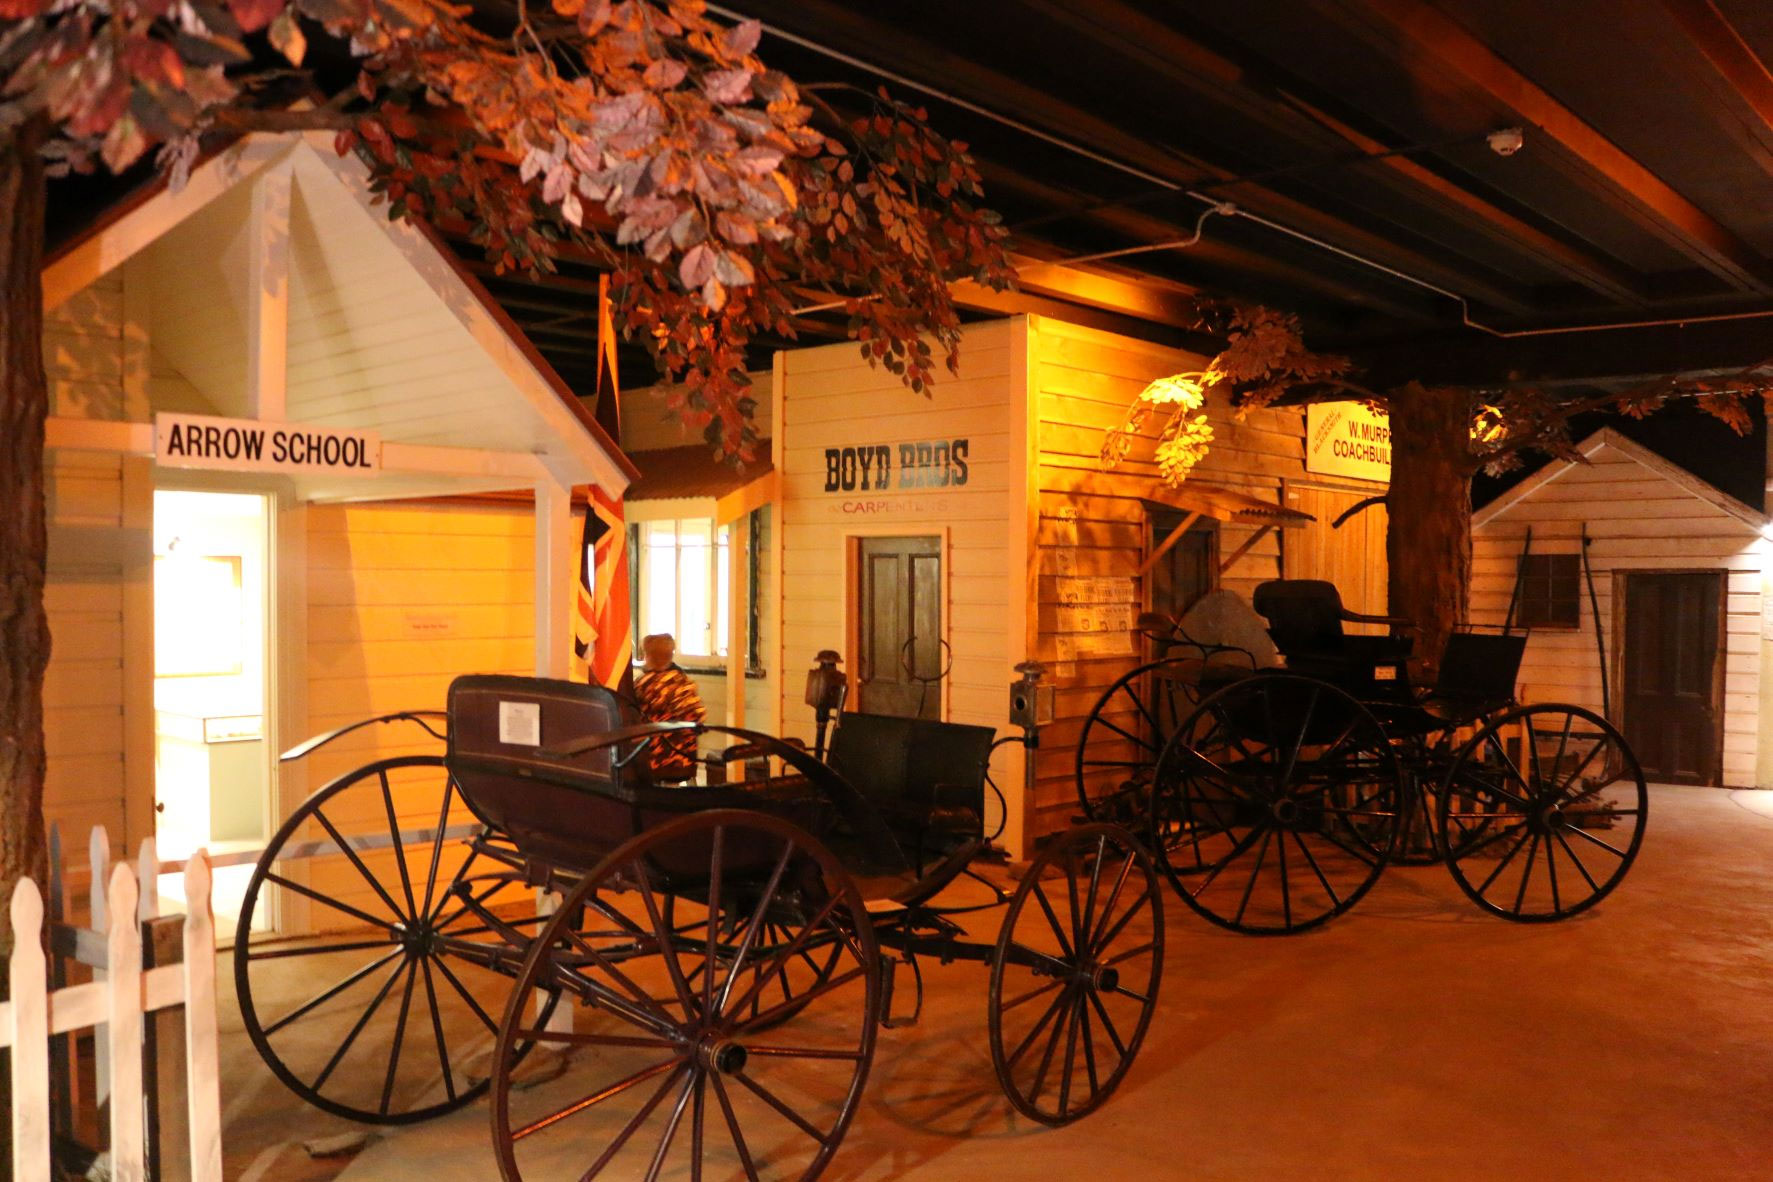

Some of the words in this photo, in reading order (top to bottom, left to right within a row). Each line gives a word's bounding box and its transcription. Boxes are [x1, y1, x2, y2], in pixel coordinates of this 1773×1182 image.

[167, 423, 265, 461] ARROW
[272, 431, 372, 468] SCHOOL
[825, 445, 891, 493] BOYD
[899, 439, 969, 489] BROS
[842, 499, 948, 514] CARPENTES
